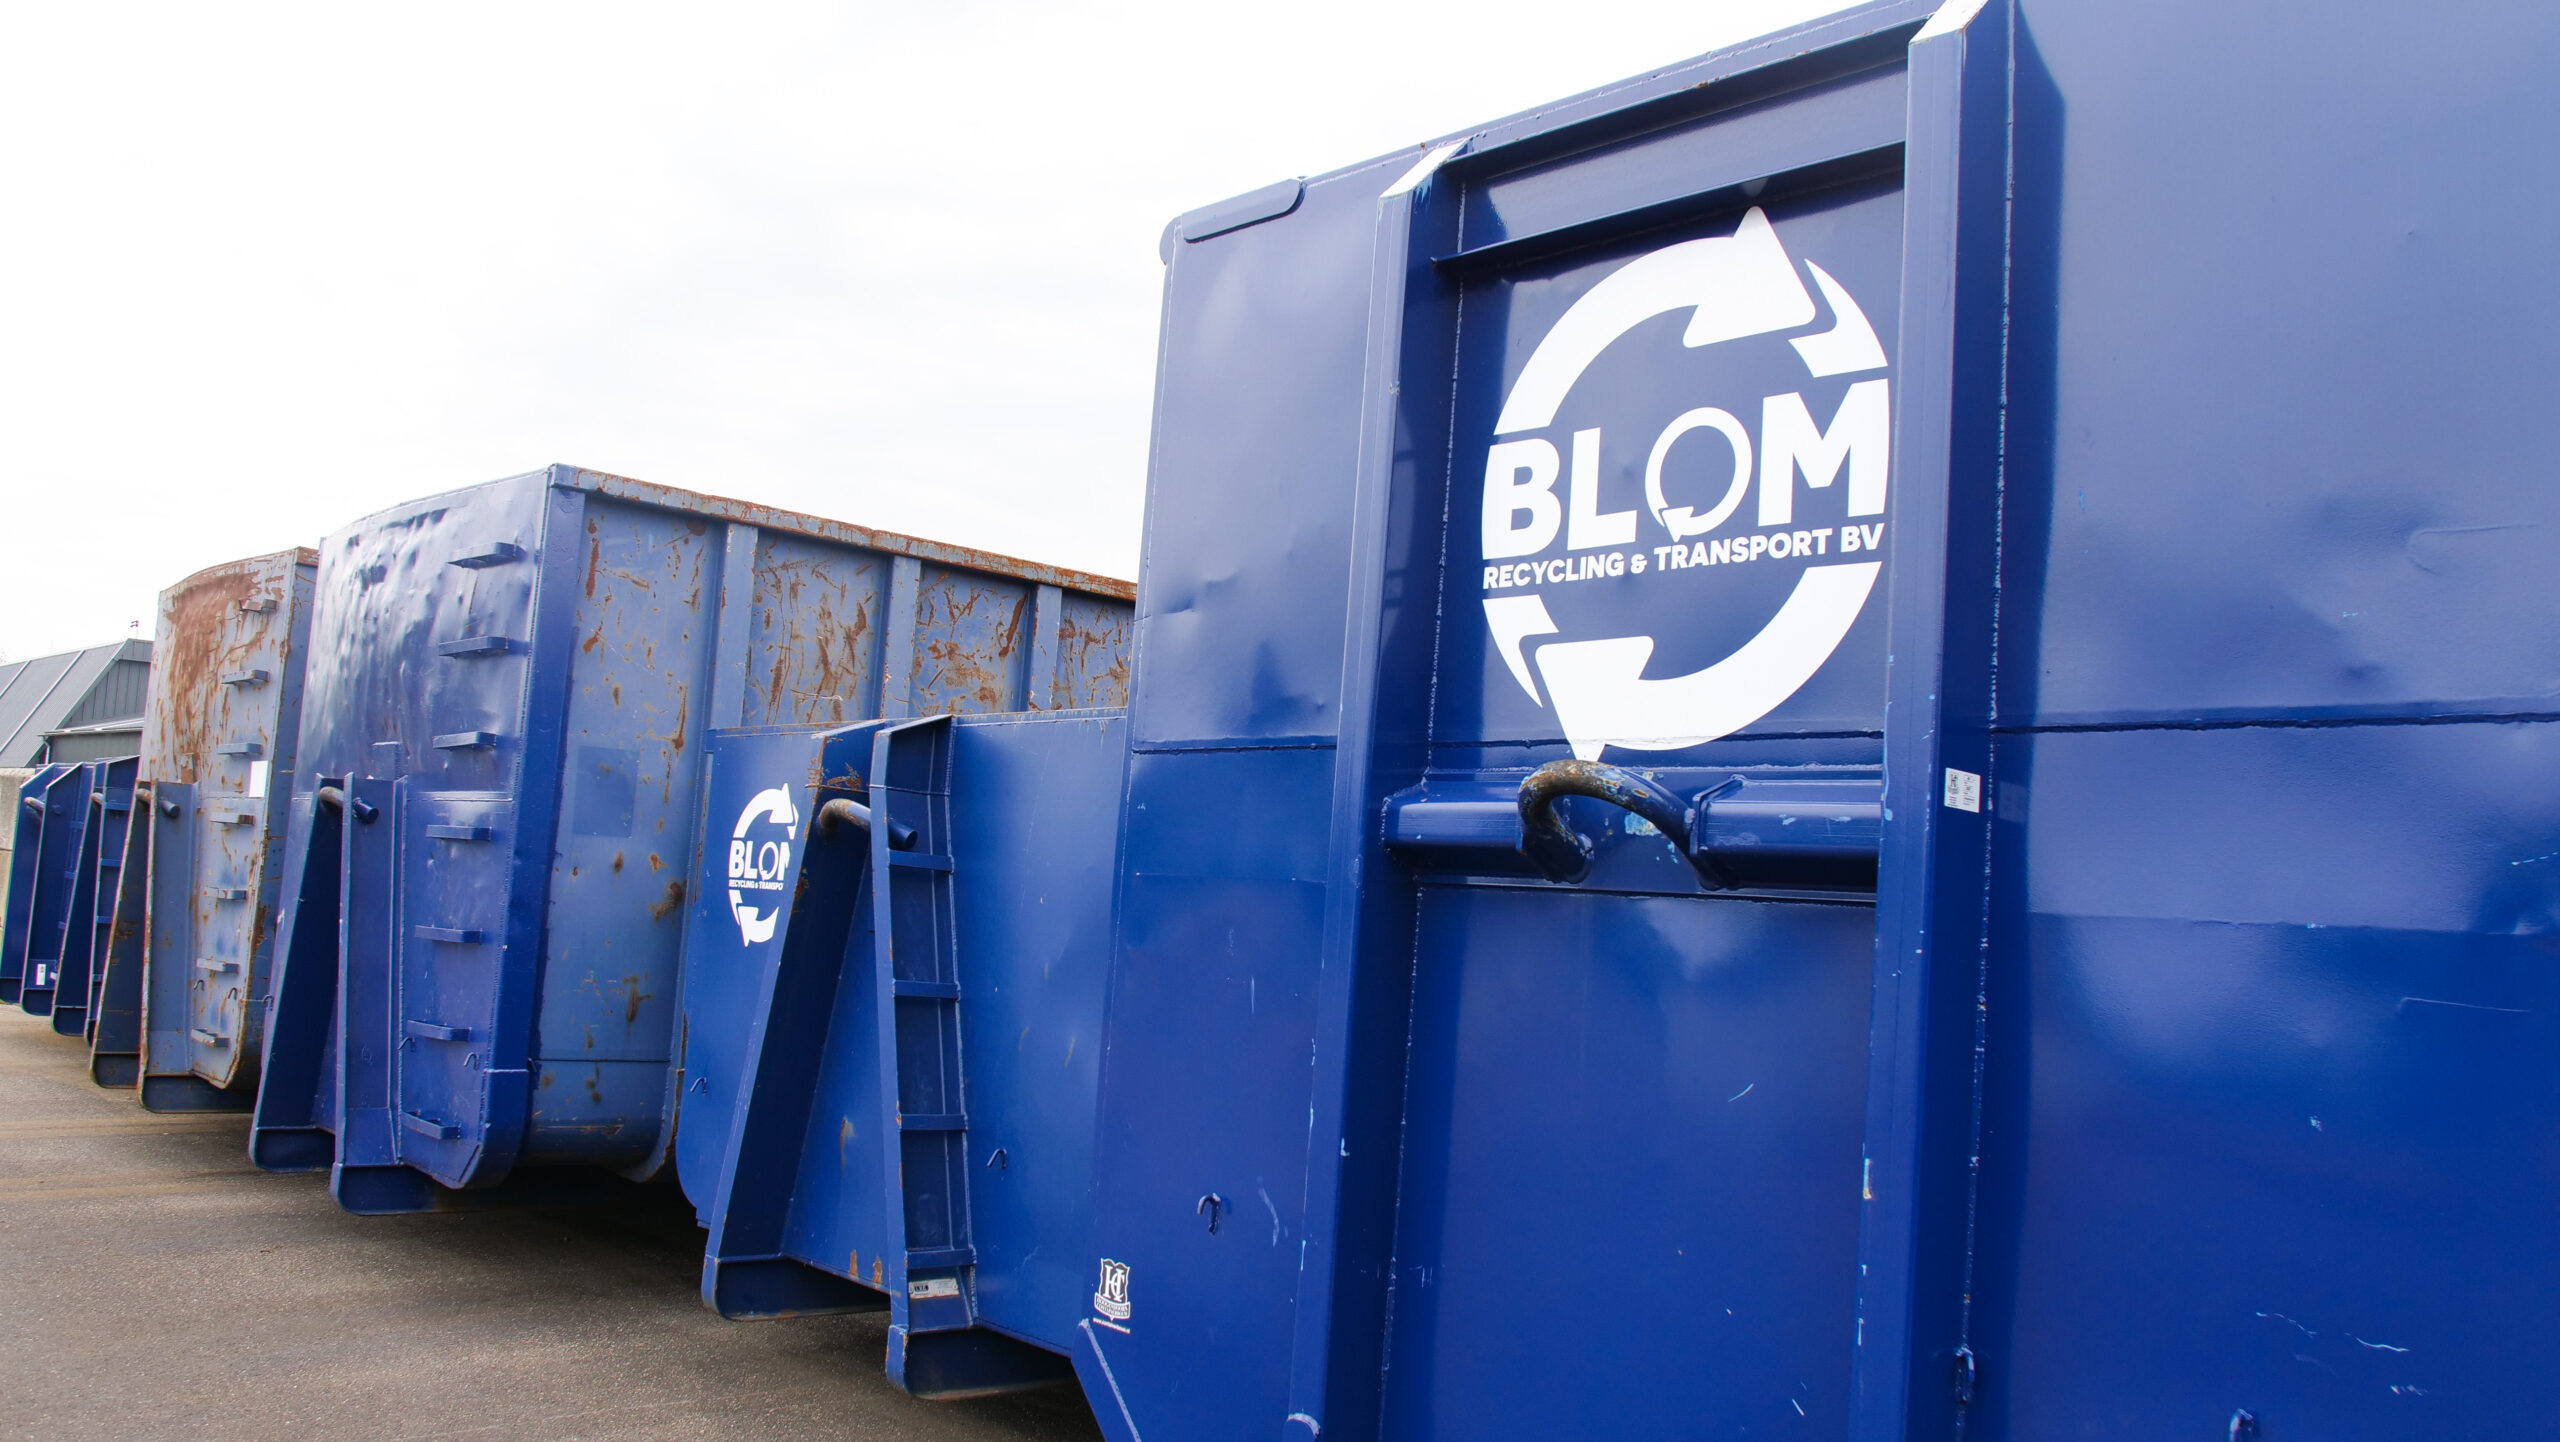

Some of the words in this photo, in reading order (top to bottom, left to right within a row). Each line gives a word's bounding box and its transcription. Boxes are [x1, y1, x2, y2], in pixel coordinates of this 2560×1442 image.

[1481, 378, 1889, 560] BLOM
[1482, 552, 1625, 590] RECYCLING
[1631, 554, 1648, 574] &
[1653, 528, 1833, 571] TRANSPORT
[1840, 523, 1885, 553] BV
